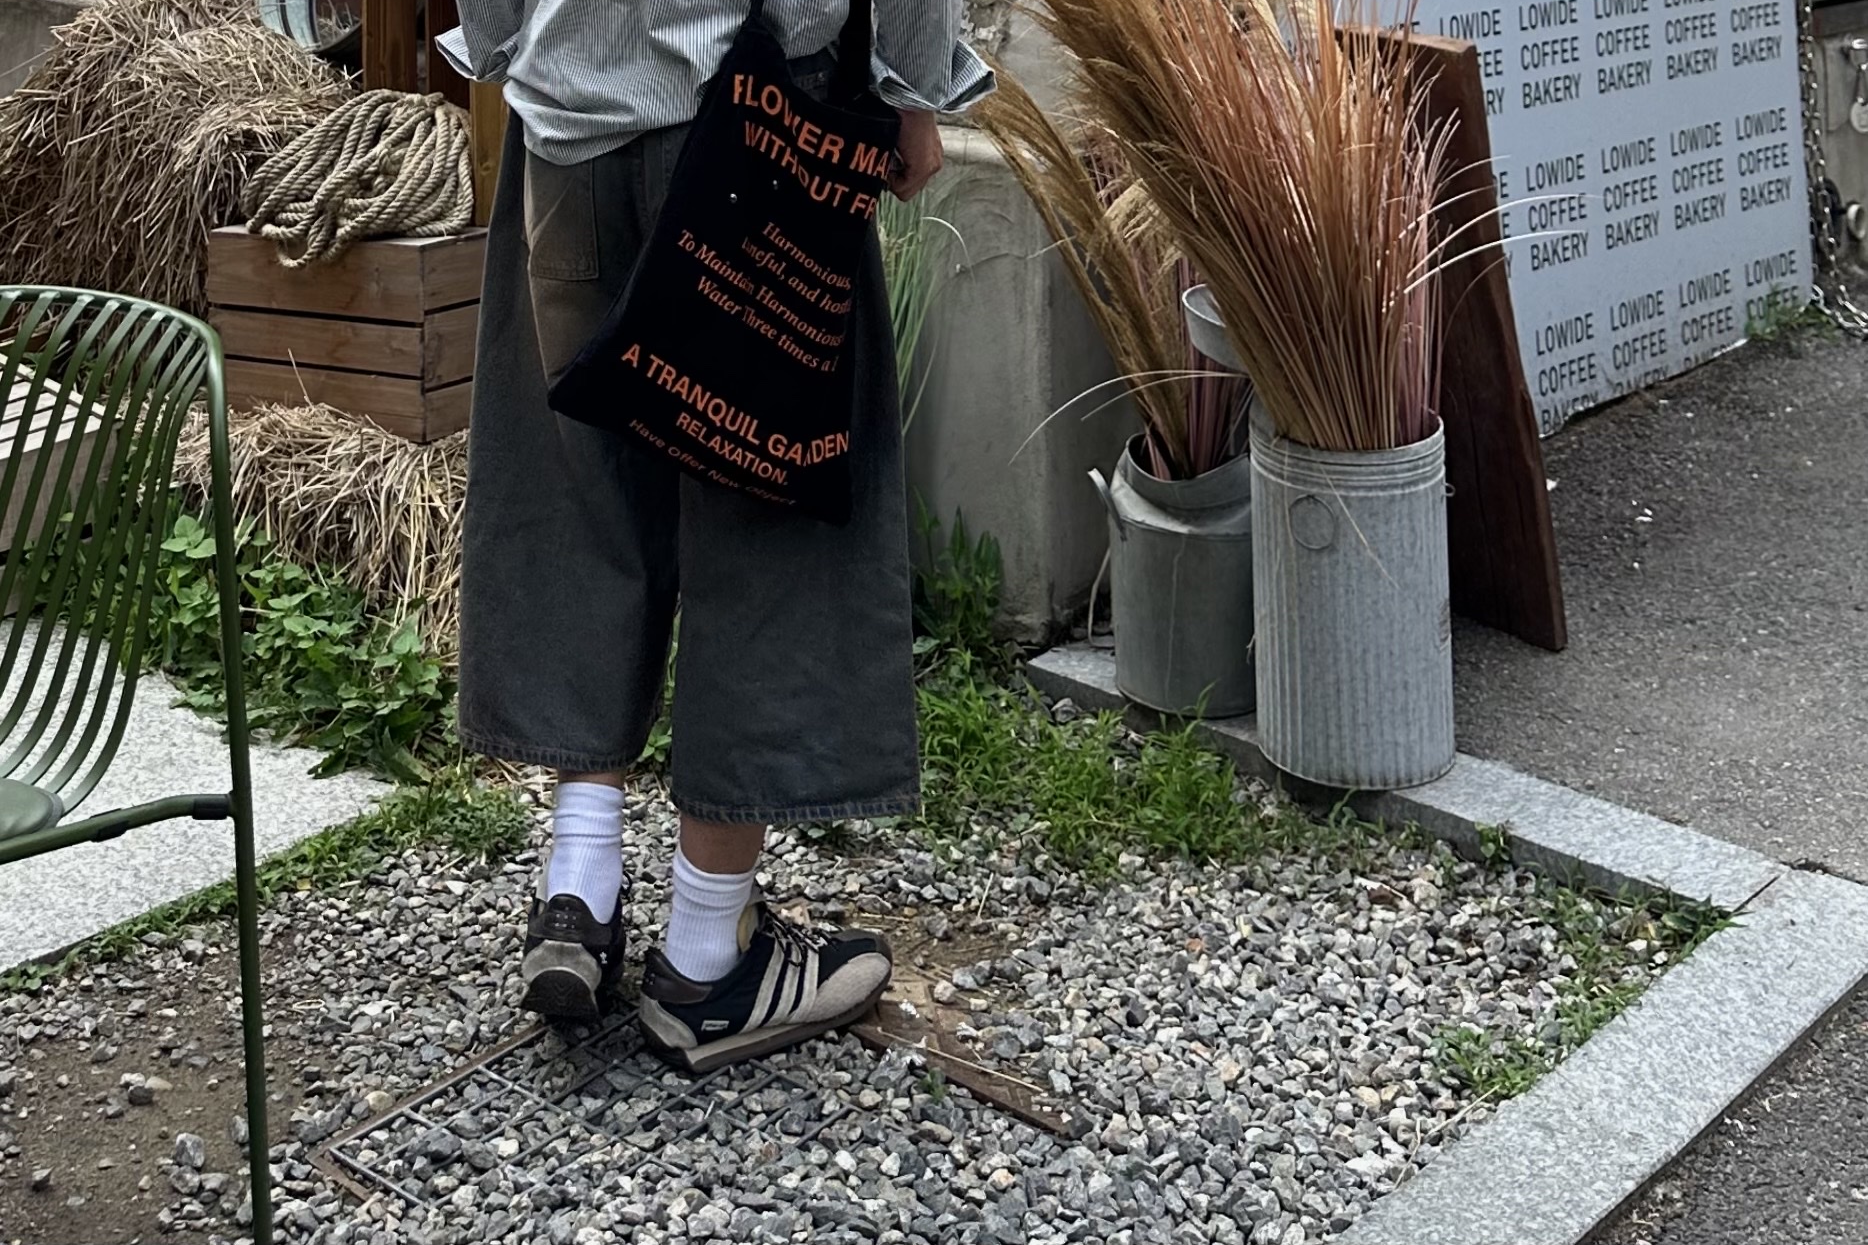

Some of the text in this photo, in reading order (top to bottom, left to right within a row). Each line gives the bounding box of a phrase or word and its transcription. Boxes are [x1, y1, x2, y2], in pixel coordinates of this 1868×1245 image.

[1521, 36, 1580, 71] COFFEE
[1596, 24, 1650, 57] COFFEE
[1665, 12, 1717, 45] COFFEE
[1730, 2, 1780, 33] COFFEE
[1522, 73, 1581, 109] BAKERY
[1597, 60, 1652, 94] BAKERY
[1667, 47, 1718, 80] BAKERY
[1732, 35, 1781, 67] BAKERY
[733, 73, 845, 164] FLOWER
[1526, 154, 1586, 192] LOWIDE
[1601, 137, 1656, 174] LOWIDE
[1670, 122, 1722, 157] LOWIDE
[1736, 107, 1787, 141] LOWIDE
[745, 120, 849, 208] WITHOUT
[1528, 193, 1588, 233] COFFEE
[1603, 175, 1658, 213] COFFEE
[1672, 158, 1724, 194] COFFEE
[1738, 142, 1789, 177] COFFEE
[677, 229, 696, 252] To
[1531, 232, 1590, 272] BAKERY
[1605, 211, 1659, 250] BAKERY
[1674, 193, 1726, 230] BAKERY
[1740, 176, 1791, 212] BAKERY
[697, 275, 743, 316] Water
[741, 305, 778, 340] Three
[777, 333, 821, 369] times
[787, 275, 822, 303] and
[1536, 312, 1594, 356] LOWIDE
[1610, 290, 1665, 332] LOWIDE
[1679, 268, 1732, 309] LOWIDE
[621, 343, 642, 369] A
[646, 354, 762, 446] TRANQUIL
[1538, 353, 1597, 397] COFFEE
[1612, 328, 1667, 373] COFFEE
[1681, 306, 1734, 346] COFFEE
[628, 418, 666, 450] Have
[667, 445, 707, 472] Offer
[675, 411, 789, 486] RELAXATION.
